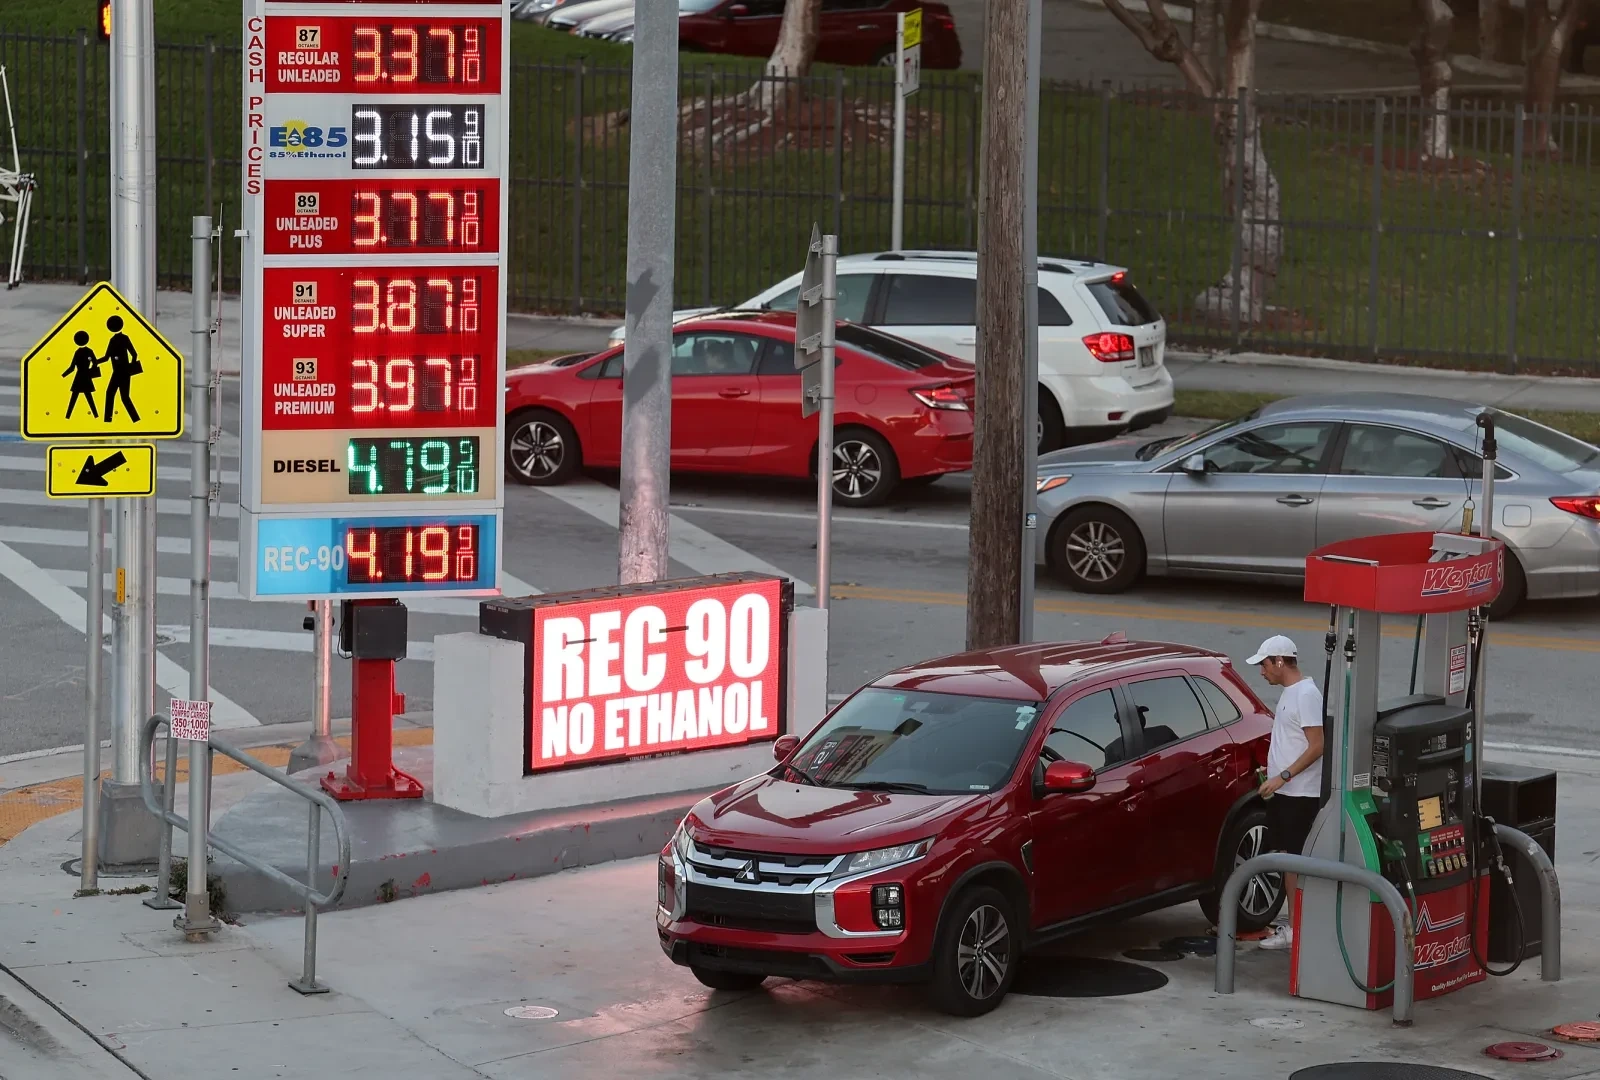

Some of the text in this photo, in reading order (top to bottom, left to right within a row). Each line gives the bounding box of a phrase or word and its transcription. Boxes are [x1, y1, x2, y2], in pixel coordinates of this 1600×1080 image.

[299, 29, 318, 42] 87
[278, 52, 340, 65] REGULAR
[354, 28, 455, 82] 3.37
[278, 69, 341, 83] UNLEADED
[247, 18, 264, 194] CASH PRICES
[354, 111, 455, 164] 3.15
[297, 195, 317, 207] 89
[276, 217, 338, 231] UNLEADED
[354, 192, 455, 245] 3.77
[289, 234, 323, 248] PLUS
[295, 284, 313, 297] 91
[353, 279, 453, 332] 3.87
[274, 306, 337, 320] UNLEADED
[282, 324, 326, 338] SUPER
[295, 361, 315, 374] 93
[274, 383, 337, 397] UNLEADED
[352, 359, 451, 412] 3.97
[275, 401, 335, 415] PREMIUM
[273, 459, 341, 473] DIESEL
[348, 441, 450, 494] 4.79
[264, 545, 344, 572] REC-90
[347, 527, 449, 580] 4.19
[1422, 562, 1493, 593] Westar
[542, 593, 770, 702] REC 90
[171, 699, 208, 712] WE BUY JUNK CAR
[171, 709, 208, 720] COMPRO CARROS
[541, 681, 768, 759] NO ETHANOL
[1465, 721, 1472, 740] 5
